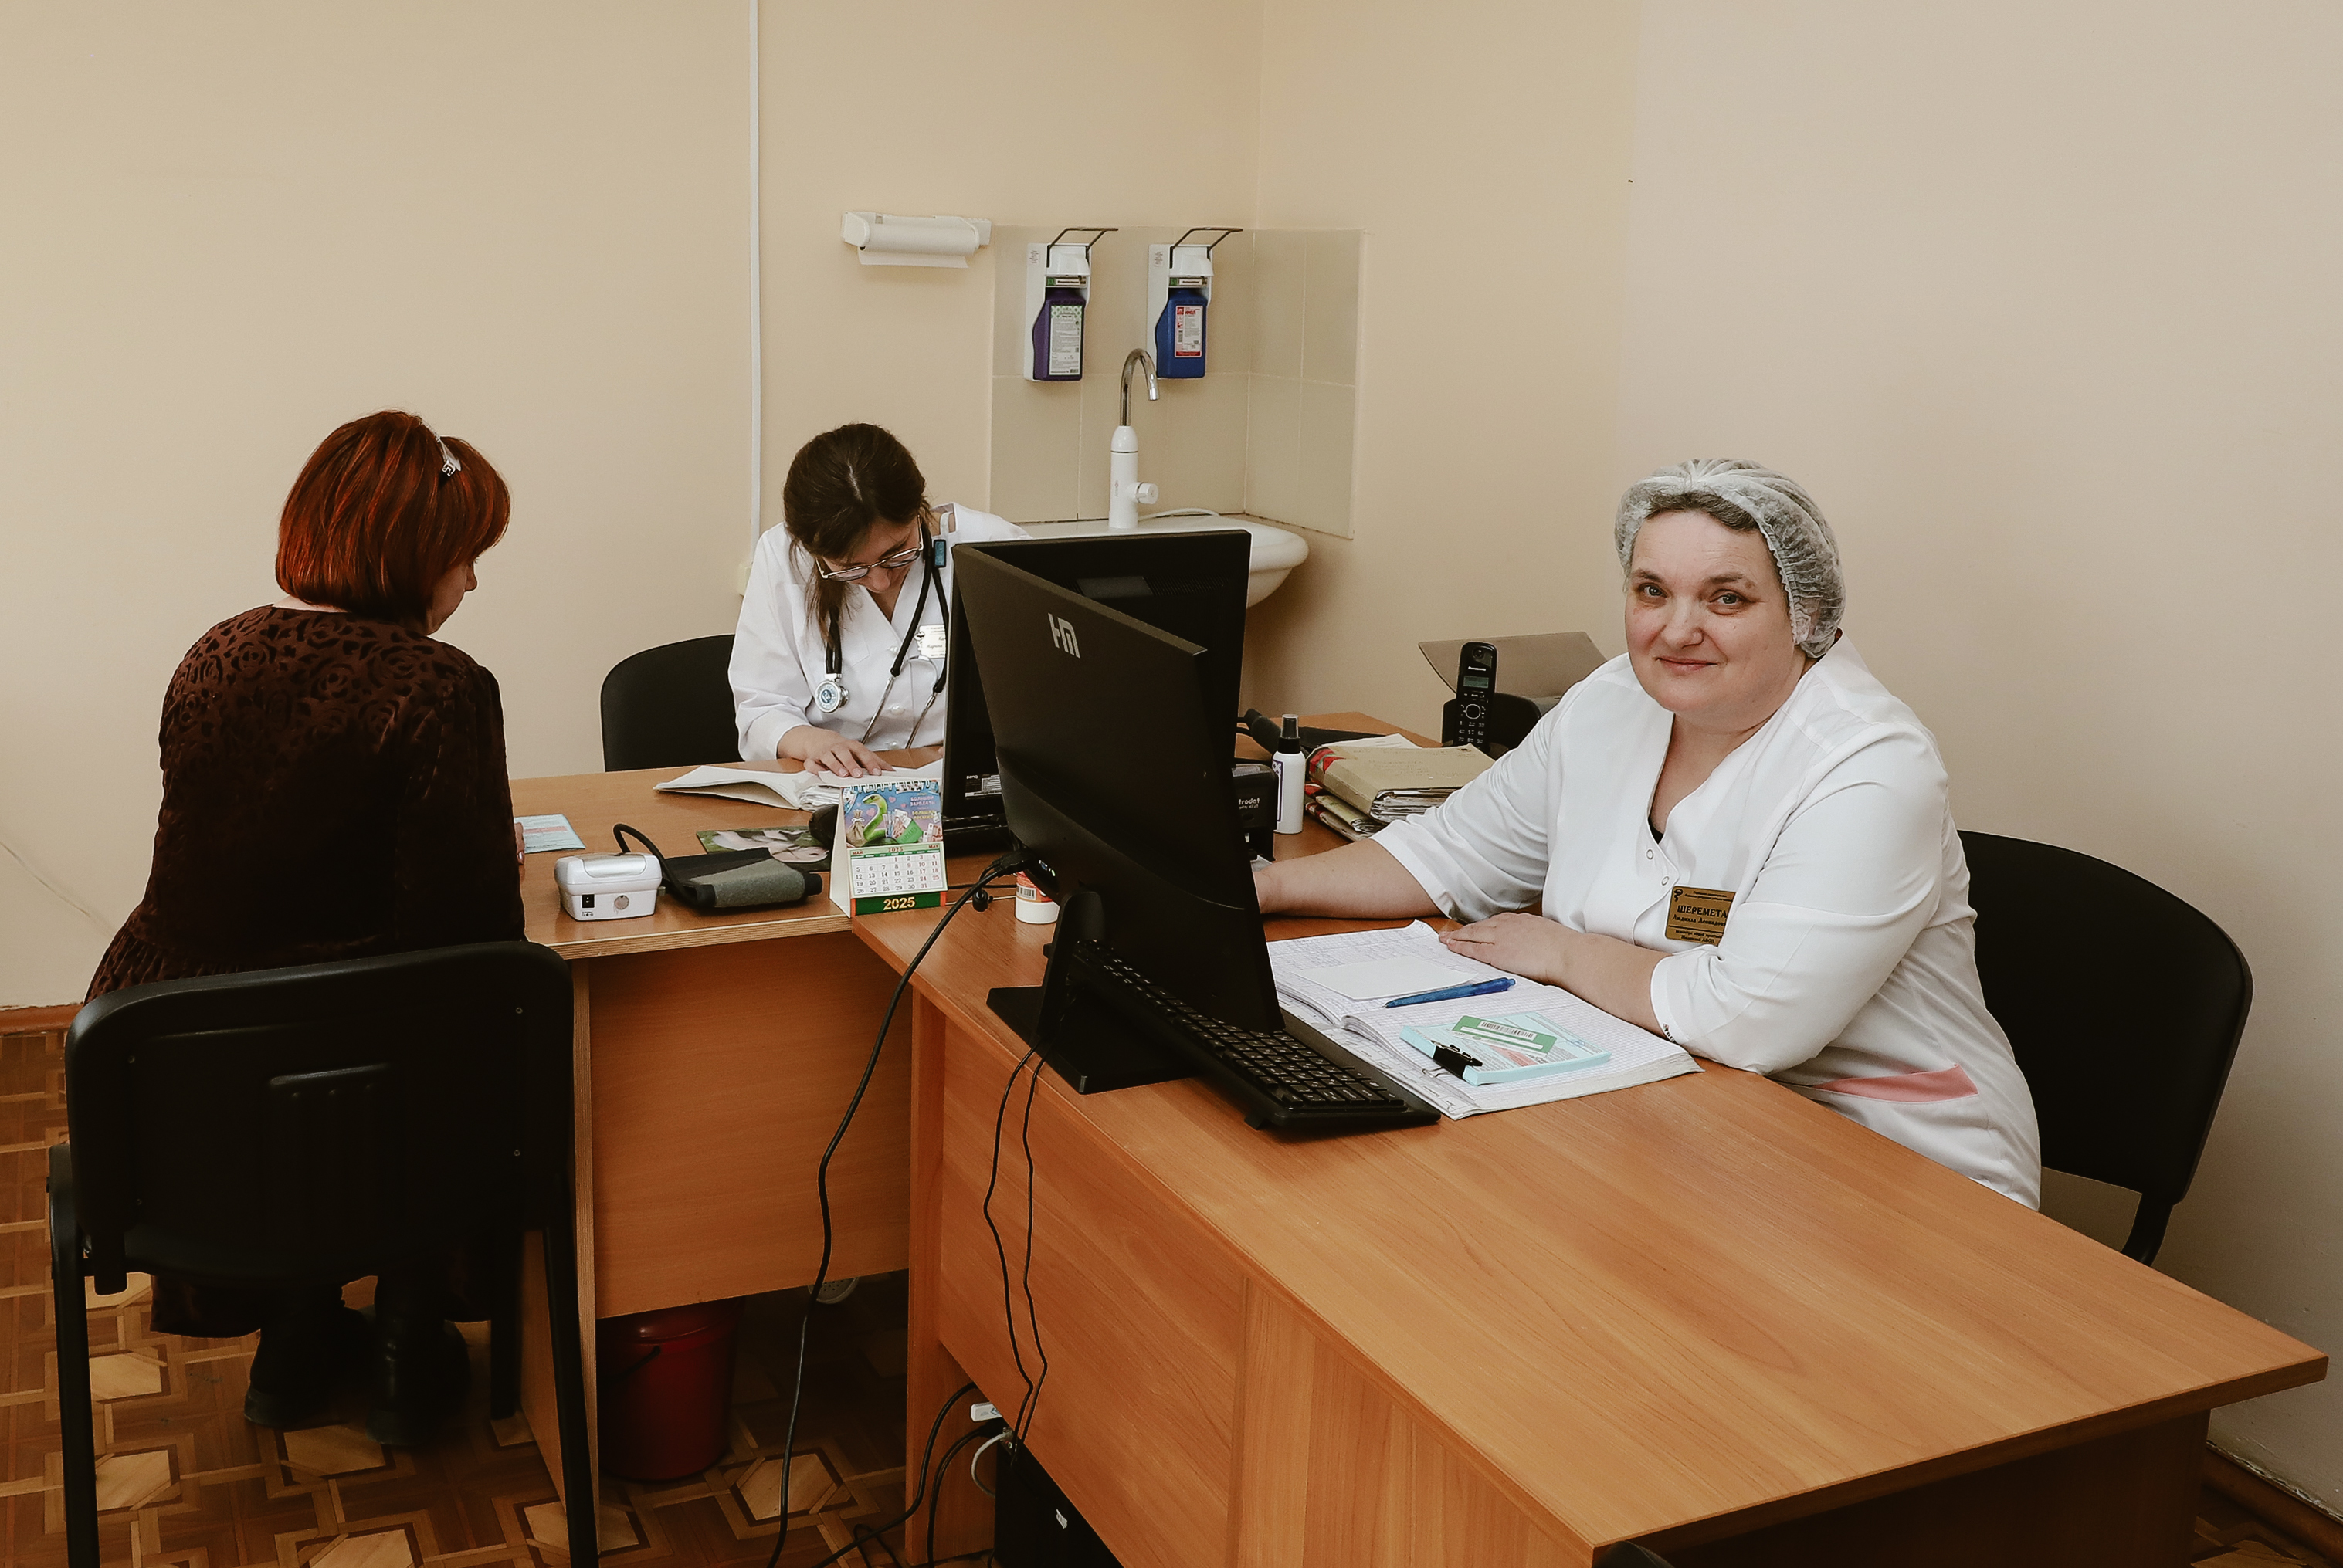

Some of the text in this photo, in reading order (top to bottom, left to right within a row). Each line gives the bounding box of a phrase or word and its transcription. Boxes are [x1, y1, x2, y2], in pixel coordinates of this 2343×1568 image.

[1238, 797, 1260, 805] trodat
[883, 896, 915, 910] 2025
[1677, 905, 1728, 918] ШЕРЕМЕТА
[1673, 914, 1697, 923] Людмила
